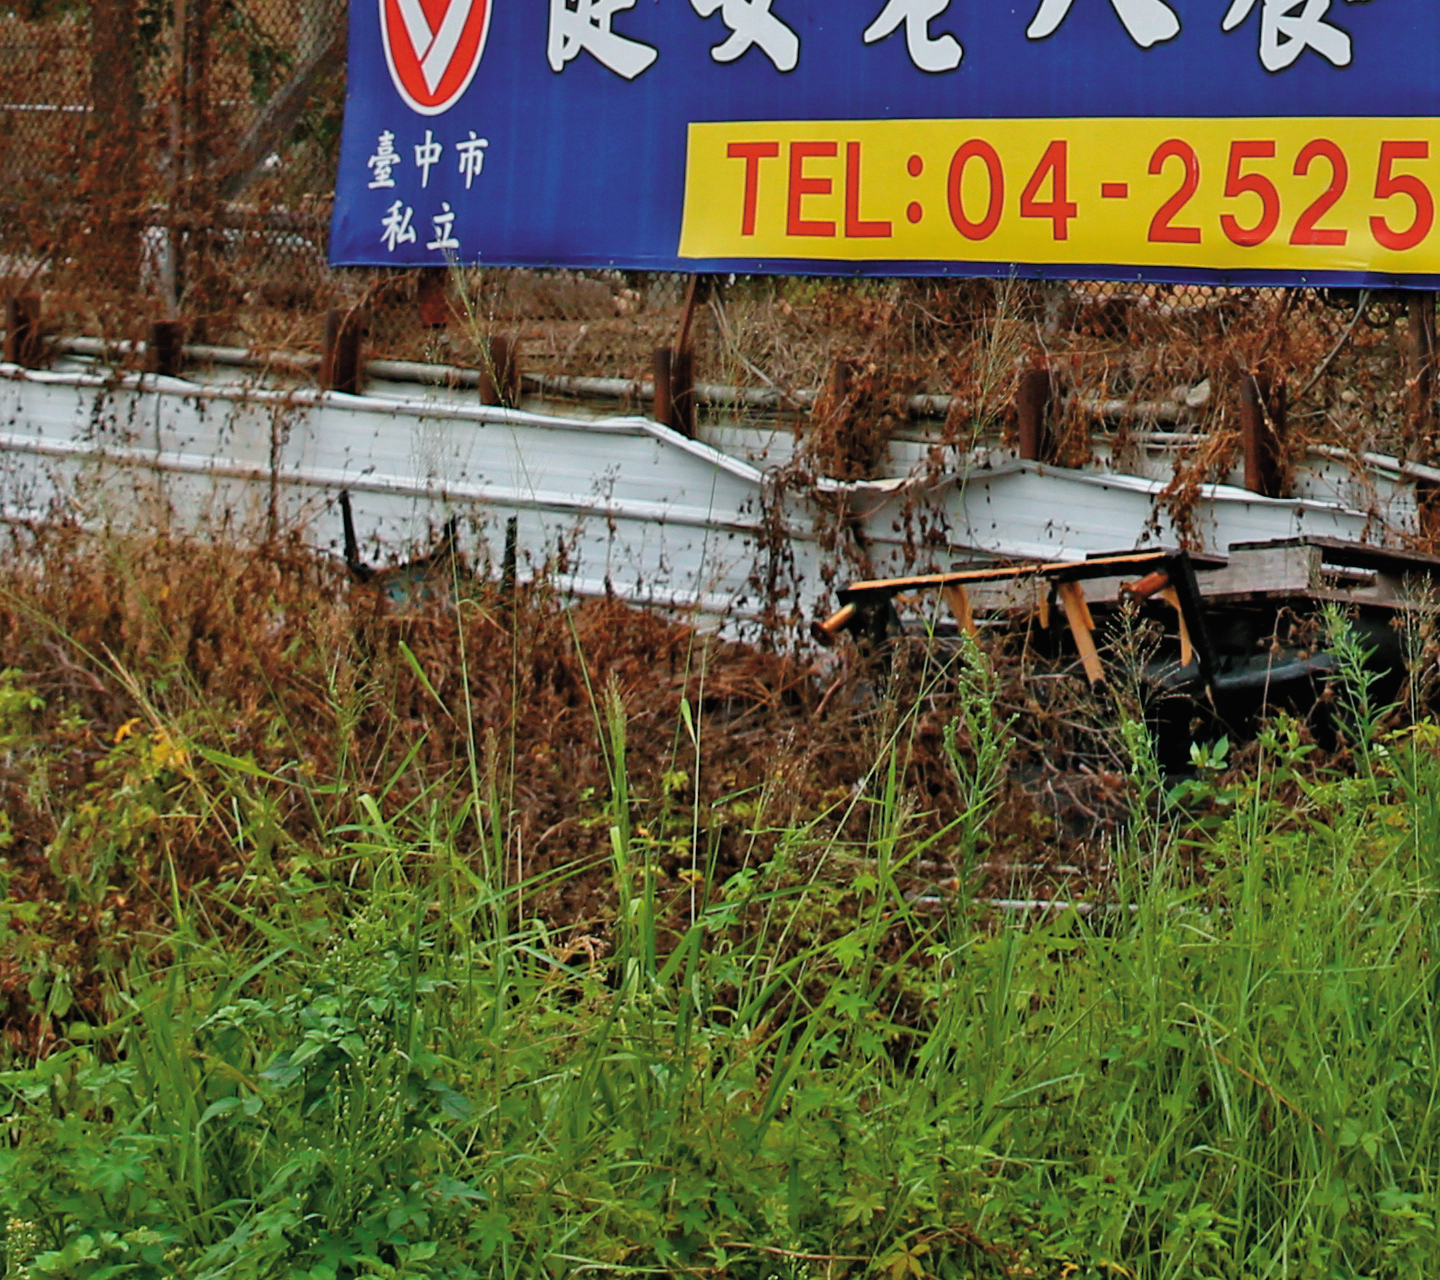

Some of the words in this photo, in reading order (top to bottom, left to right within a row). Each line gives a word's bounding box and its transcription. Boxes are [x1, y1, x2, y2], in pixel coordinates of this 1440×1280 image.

[366, 128, 490, 190] 臺中市
[379, 198, 461, 253] 私立
